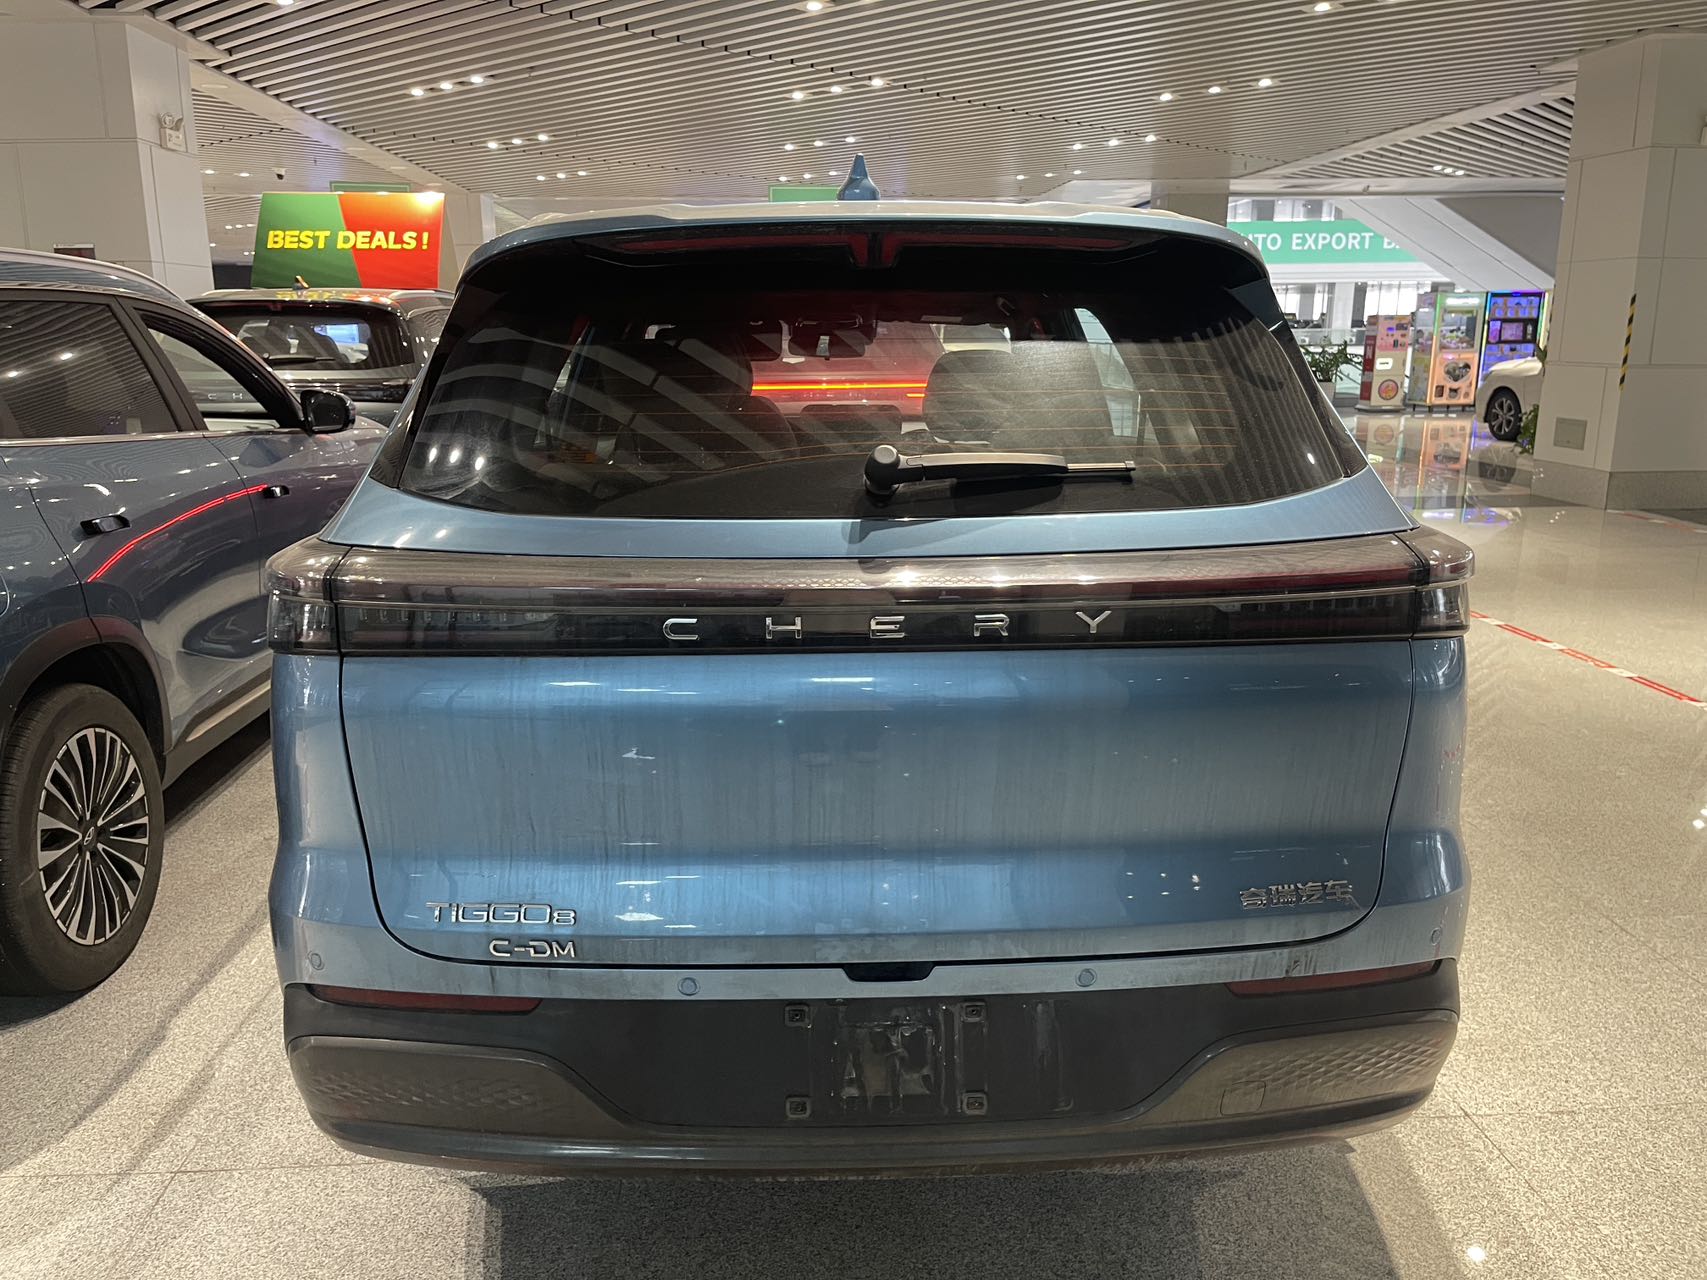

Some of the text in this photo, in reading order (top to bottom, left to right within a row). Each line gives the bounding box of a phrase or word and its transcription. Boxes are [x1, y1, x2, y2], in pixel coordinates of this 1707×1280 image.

[267, 230, 331, 249] BEST
[1248, 233, 1282, 251] TO
[1291, 232, 1374, 250] EXPORT
[663, 610, 1112, 641] CHERY
[1239, 879, 1353, 910] 奇瑞汽车
[488, 939, 576, 958] C-DM
